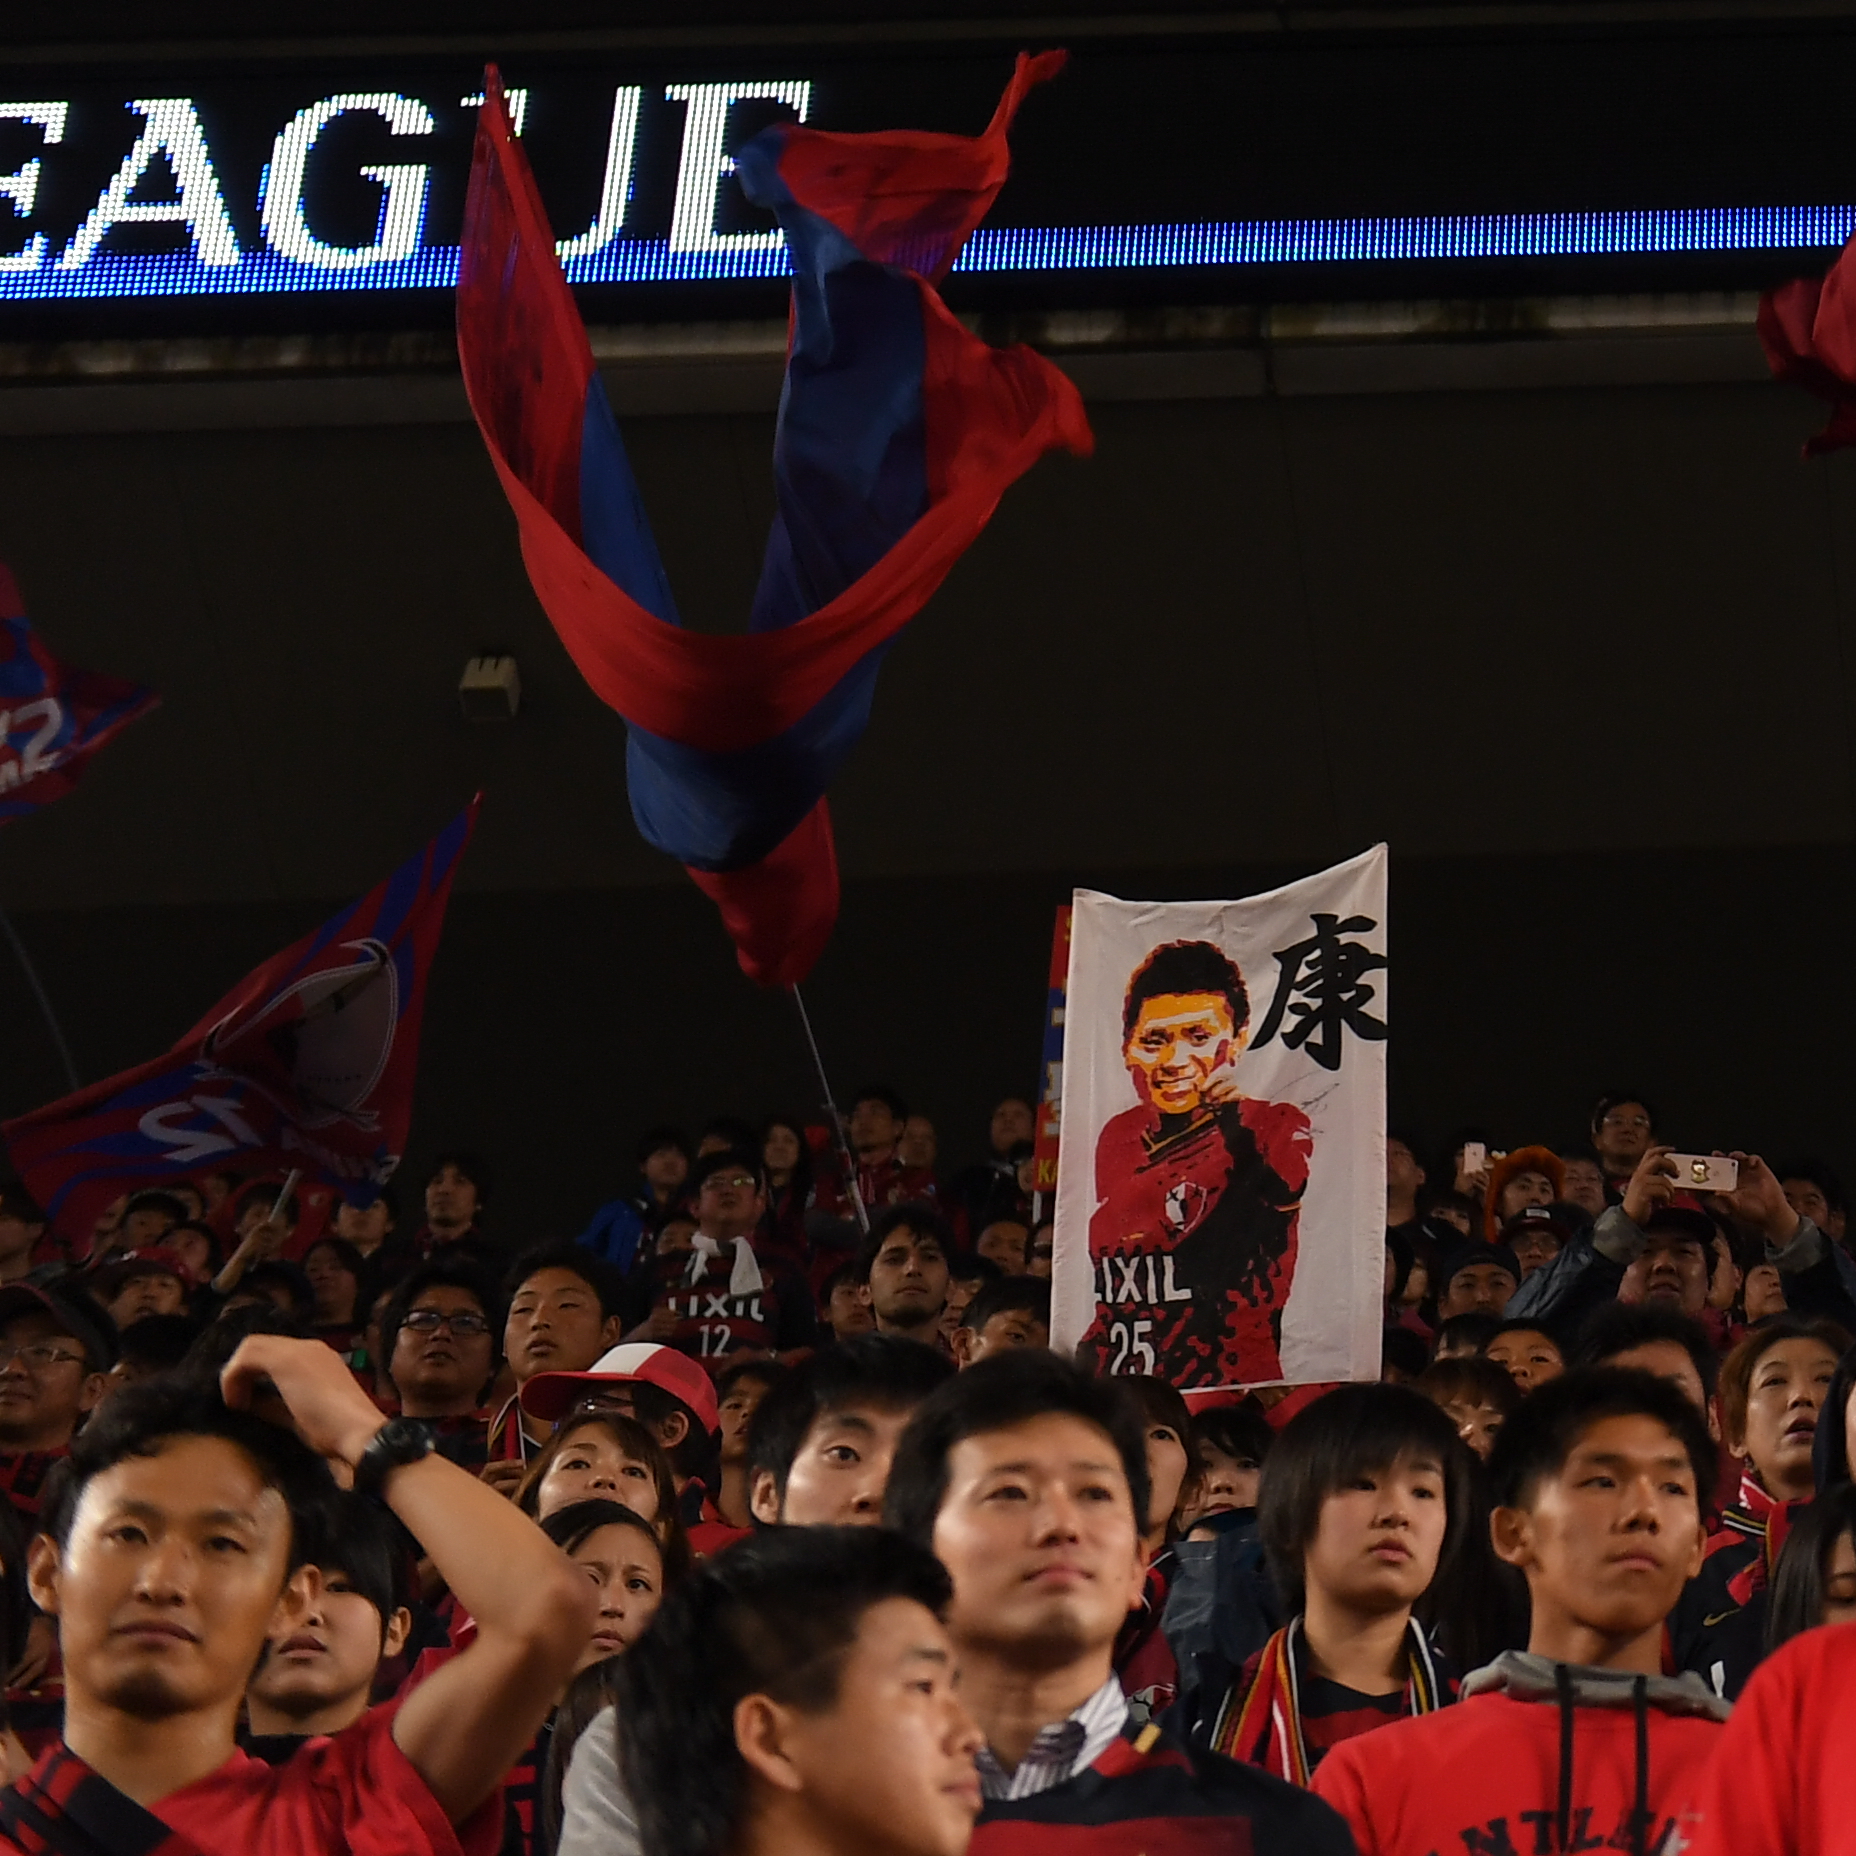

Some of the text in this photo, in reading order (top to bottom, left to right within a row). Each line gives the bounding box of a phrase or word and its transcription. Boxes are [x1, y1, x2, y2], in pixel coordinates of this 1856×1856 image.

[1247, 913, 1389, 1072] 康
[699, 1324, 732, 1358] 12
[1110, 1319, 1154, 1376] 25
